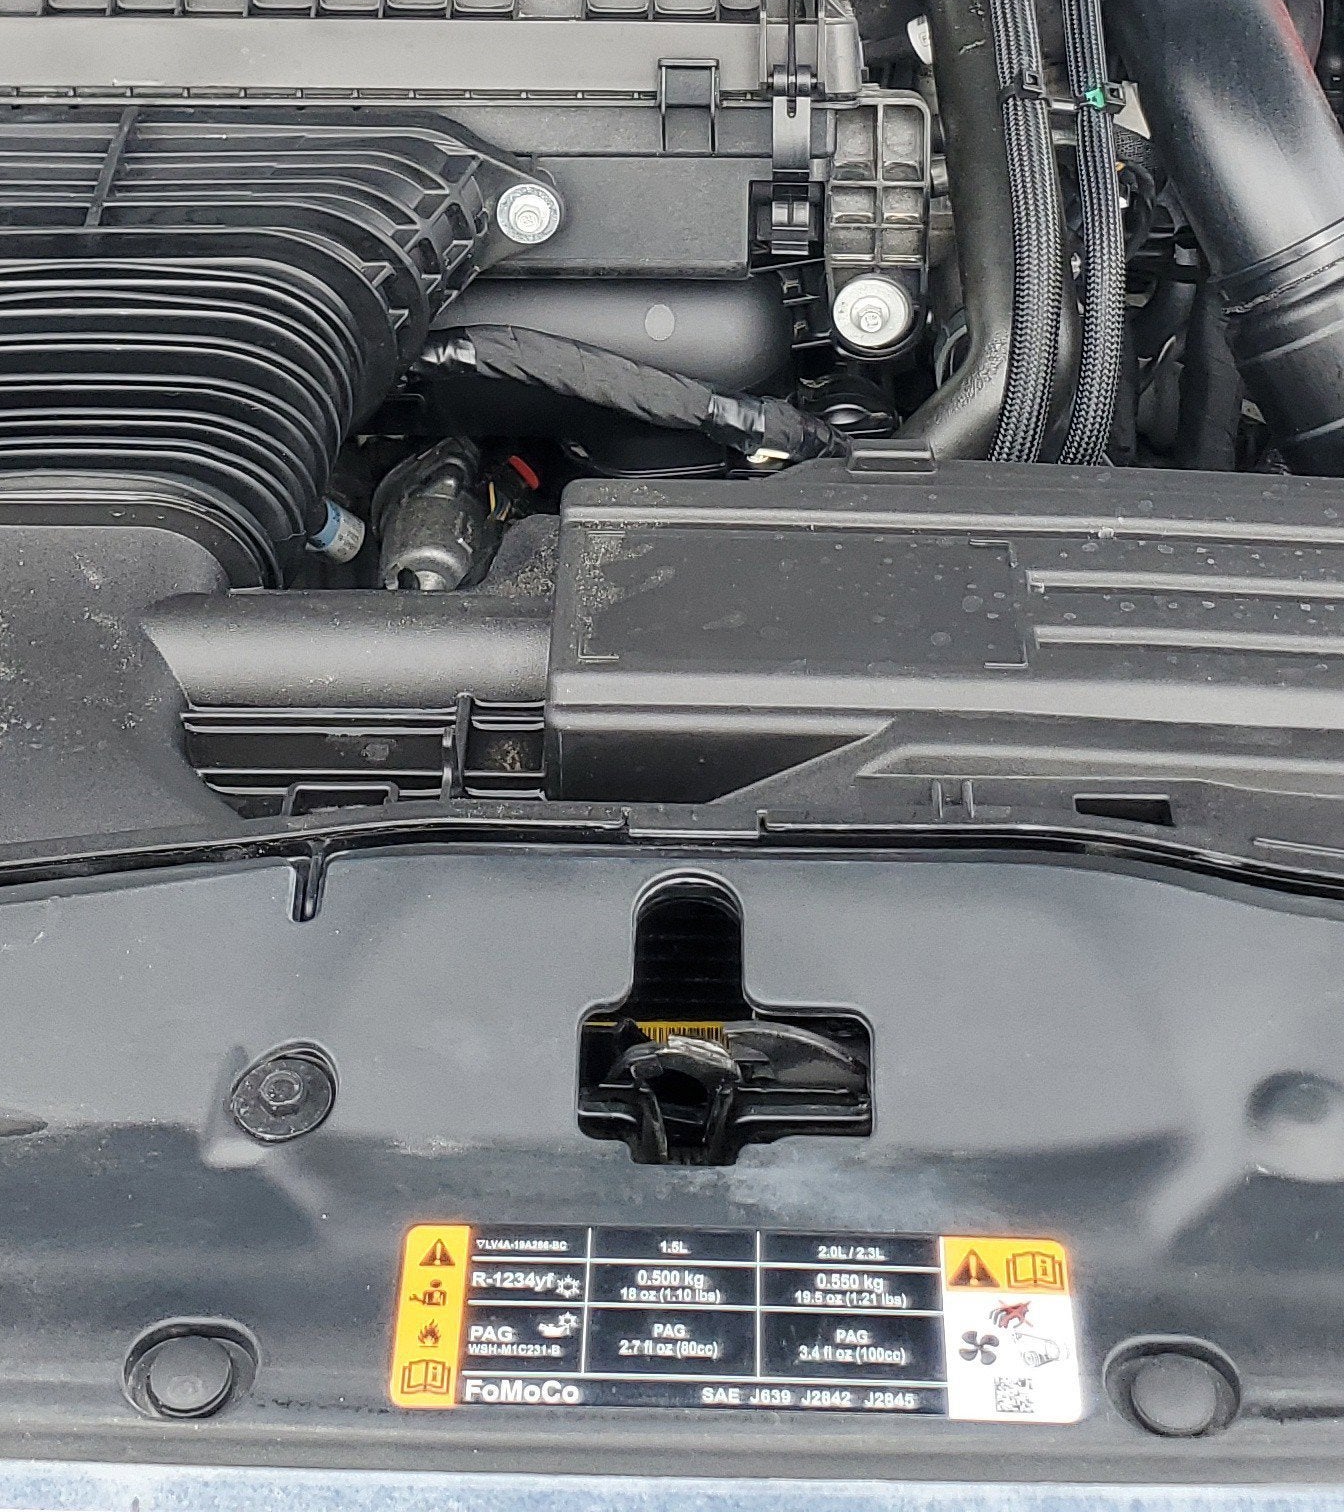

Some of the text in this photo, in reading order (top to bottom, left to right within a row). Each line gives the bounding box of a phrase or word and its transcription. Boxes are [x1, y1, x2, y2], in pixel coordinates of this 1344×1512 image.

[660, 1240, 690, 1254] 1.5L
[817, 1245, 847, 1259] 2.0L
[856, 1246, 887, 1261] 2.3L
[472, 1271, 555, 1292] R-1234yf
[637, 1269, 704, 1289] 0.500 kg
[816, 1273, 884, 1293] 0.550 kg
[620, 1286, 721, 1304] 18 oz (1.10 lbs)
[794, 1290, 907, 1309] 19.5 oz (1.21 lbs)
[470, 1325, 513, 1343] PAG
[653, 1323, 687, 1339] PAG
[836, 1329, 868, 1344] PAG
[618, 1339, 718, 1359] 2.7 fl oz (80cc)
[799, 1344, 906, 1365] 3.4 fl oz (100cc)
[465, 1379, 579, 1404] FoMoCo
[702, 1387, 740, 1404] SAE
[749, 1388, 792, 1405] J639
